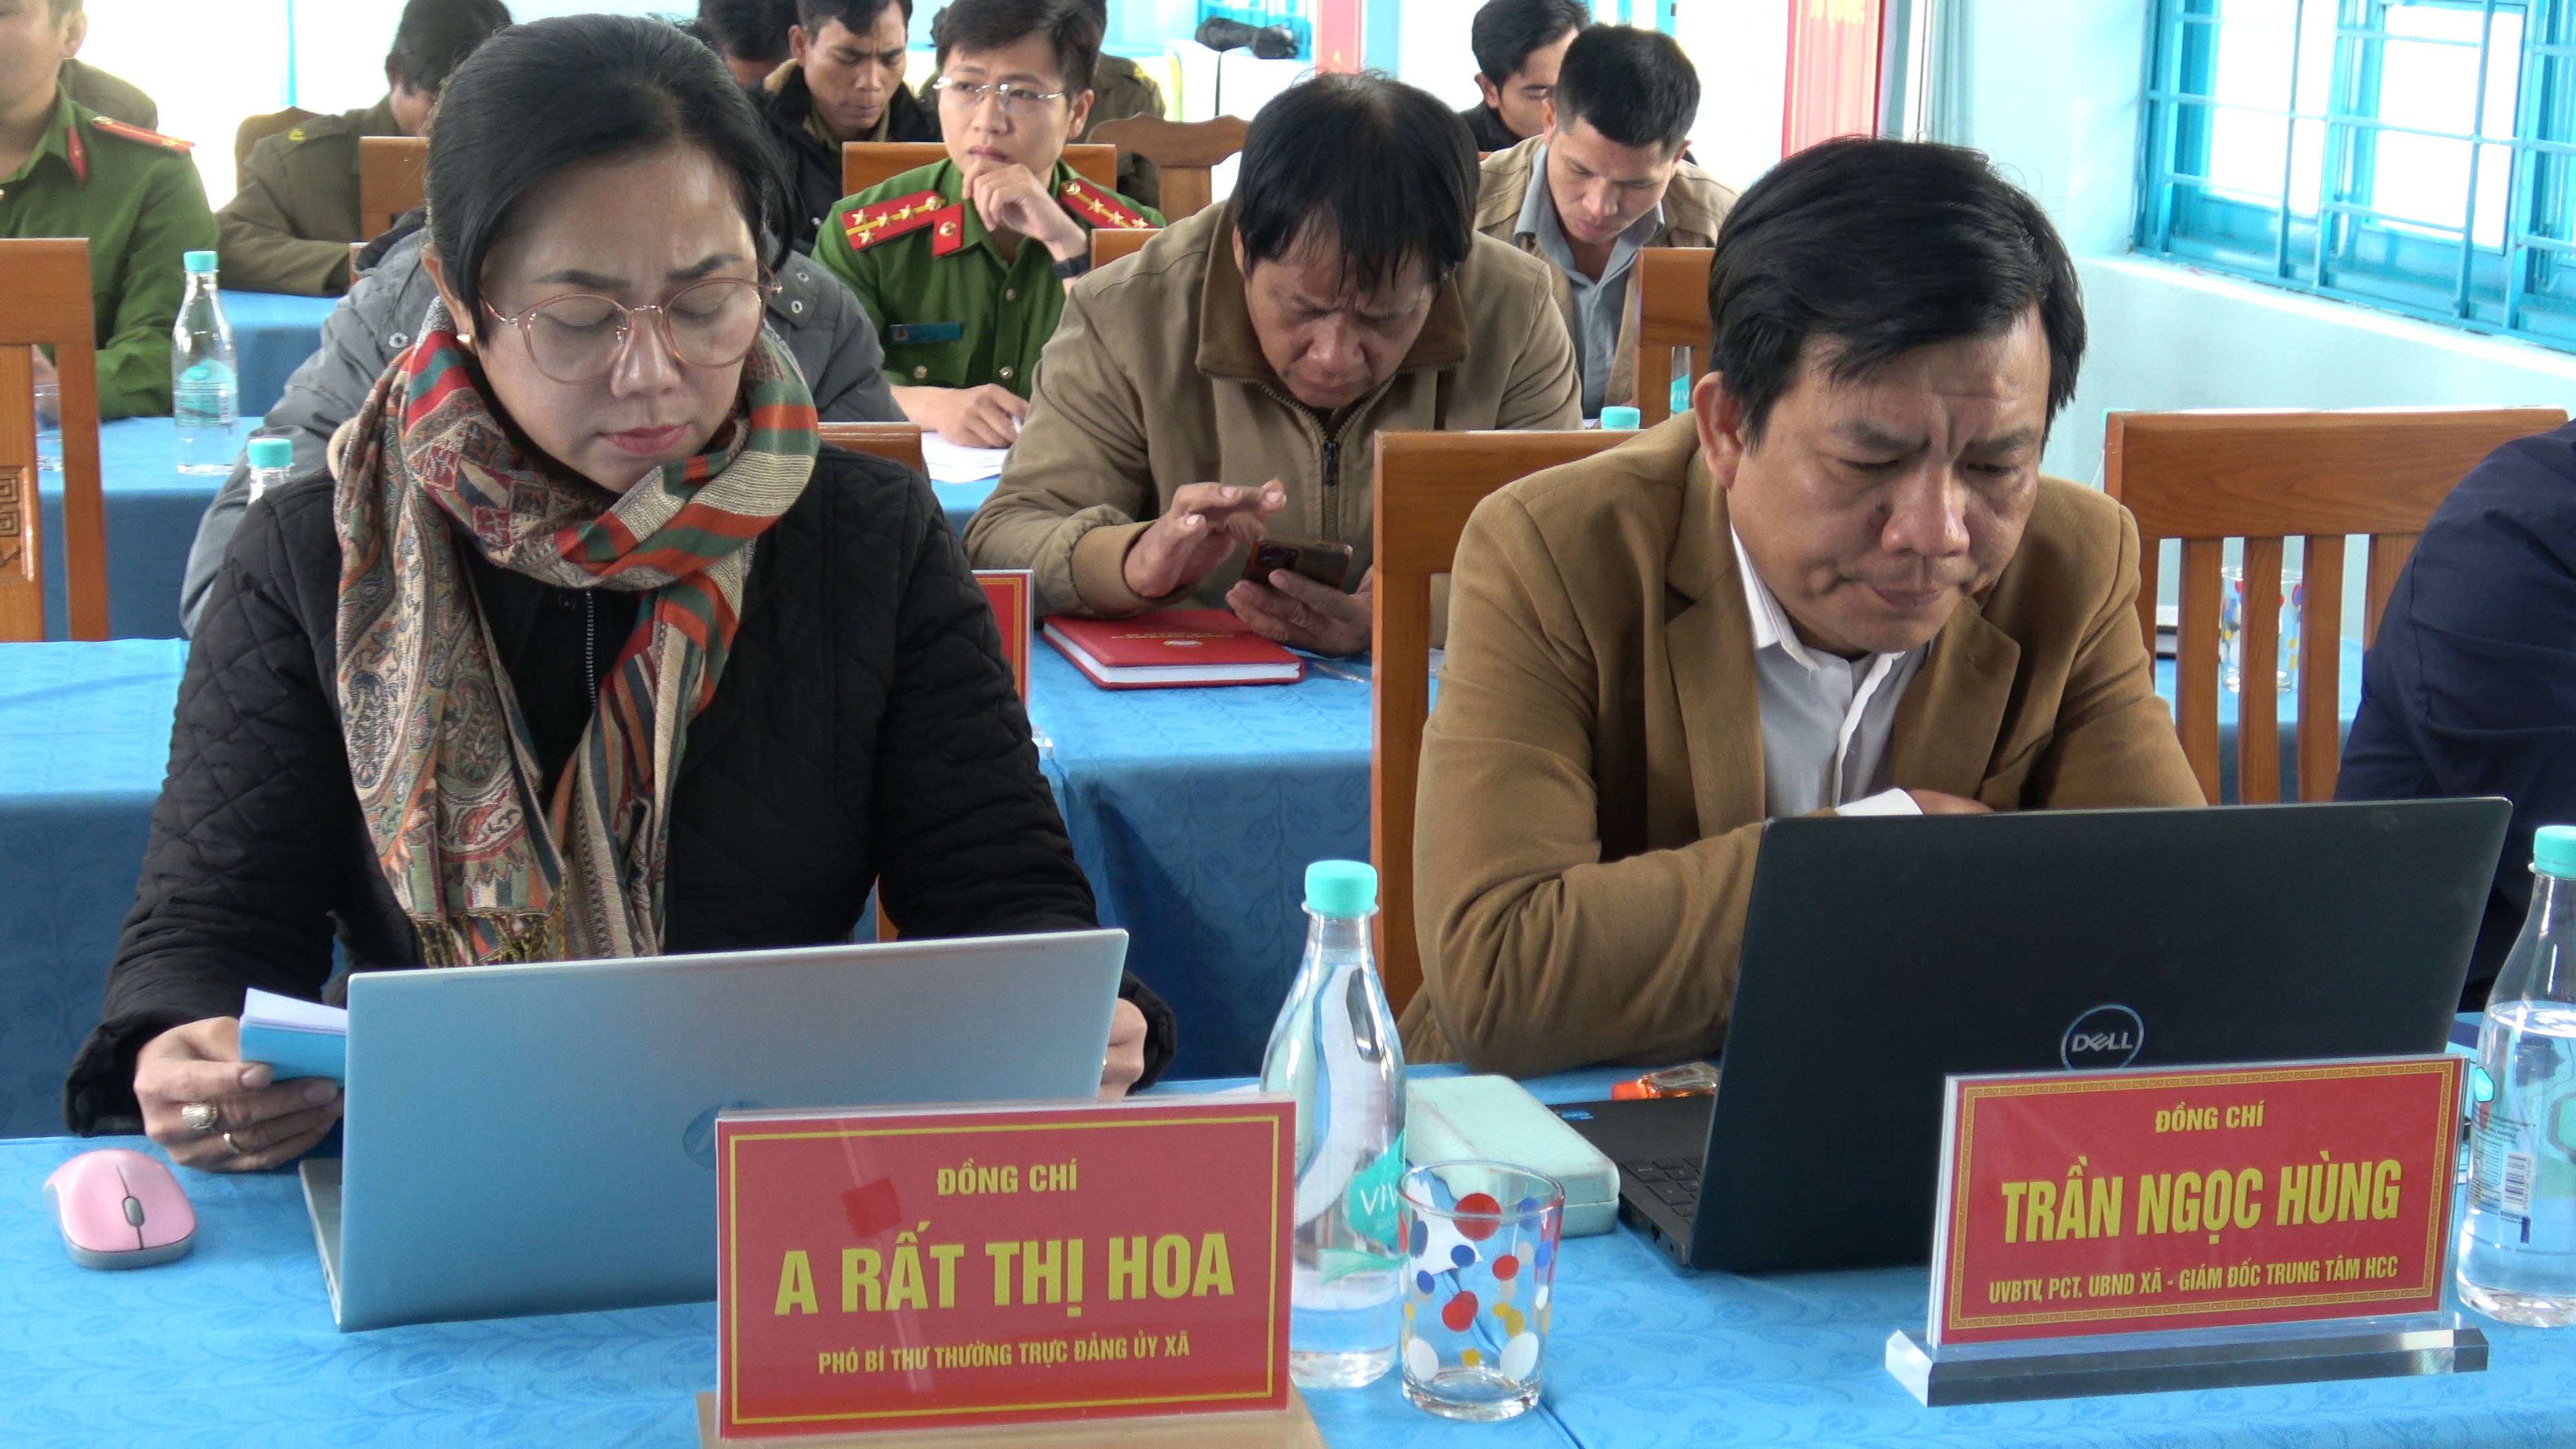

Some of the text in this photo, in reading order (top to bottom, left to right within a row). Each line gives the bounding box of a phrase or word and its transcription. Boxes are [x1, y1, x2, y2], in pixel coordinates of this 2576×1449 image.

[2071, 1031, 2134, 1053] DELL
[2155, 1100, 2265, 1133] ĐỒNG CHÍ
[936, 1158, 1078, 1197] ĐỒNG CHÍ
[2001, 1155, 2125, 1243] TRẦN
[2136, 1167, 2264, 1245] NGỌC
[2276, 1150, 2402, 1226] HÙNG
[774, 1220, 1235, 1318] A RẤT THỊ HOA
[1989, 1278, 2043, 1304] UVBTV,
[2047, 1276, 2083, 1300] PCT.
[2088, 1272, 2136, 1297] UBND
[2139, 1267, 2163, 1294] XÃ
[2178, 1263, 2224, 1291] GIÁM
[2226, 1257, 2262, 1289] ĐỐC
[2265, 1260, 2321, 1285] TRUNG
[2324, 1252, 2361, 1281] TÂM
[2365, 1255, 2399, 1279] HCC
[818, 1328, 1191, 1374] PHÓ BÍ THƯ THƯỜNG TRỰC ĐẢNG ỦY XÃ
